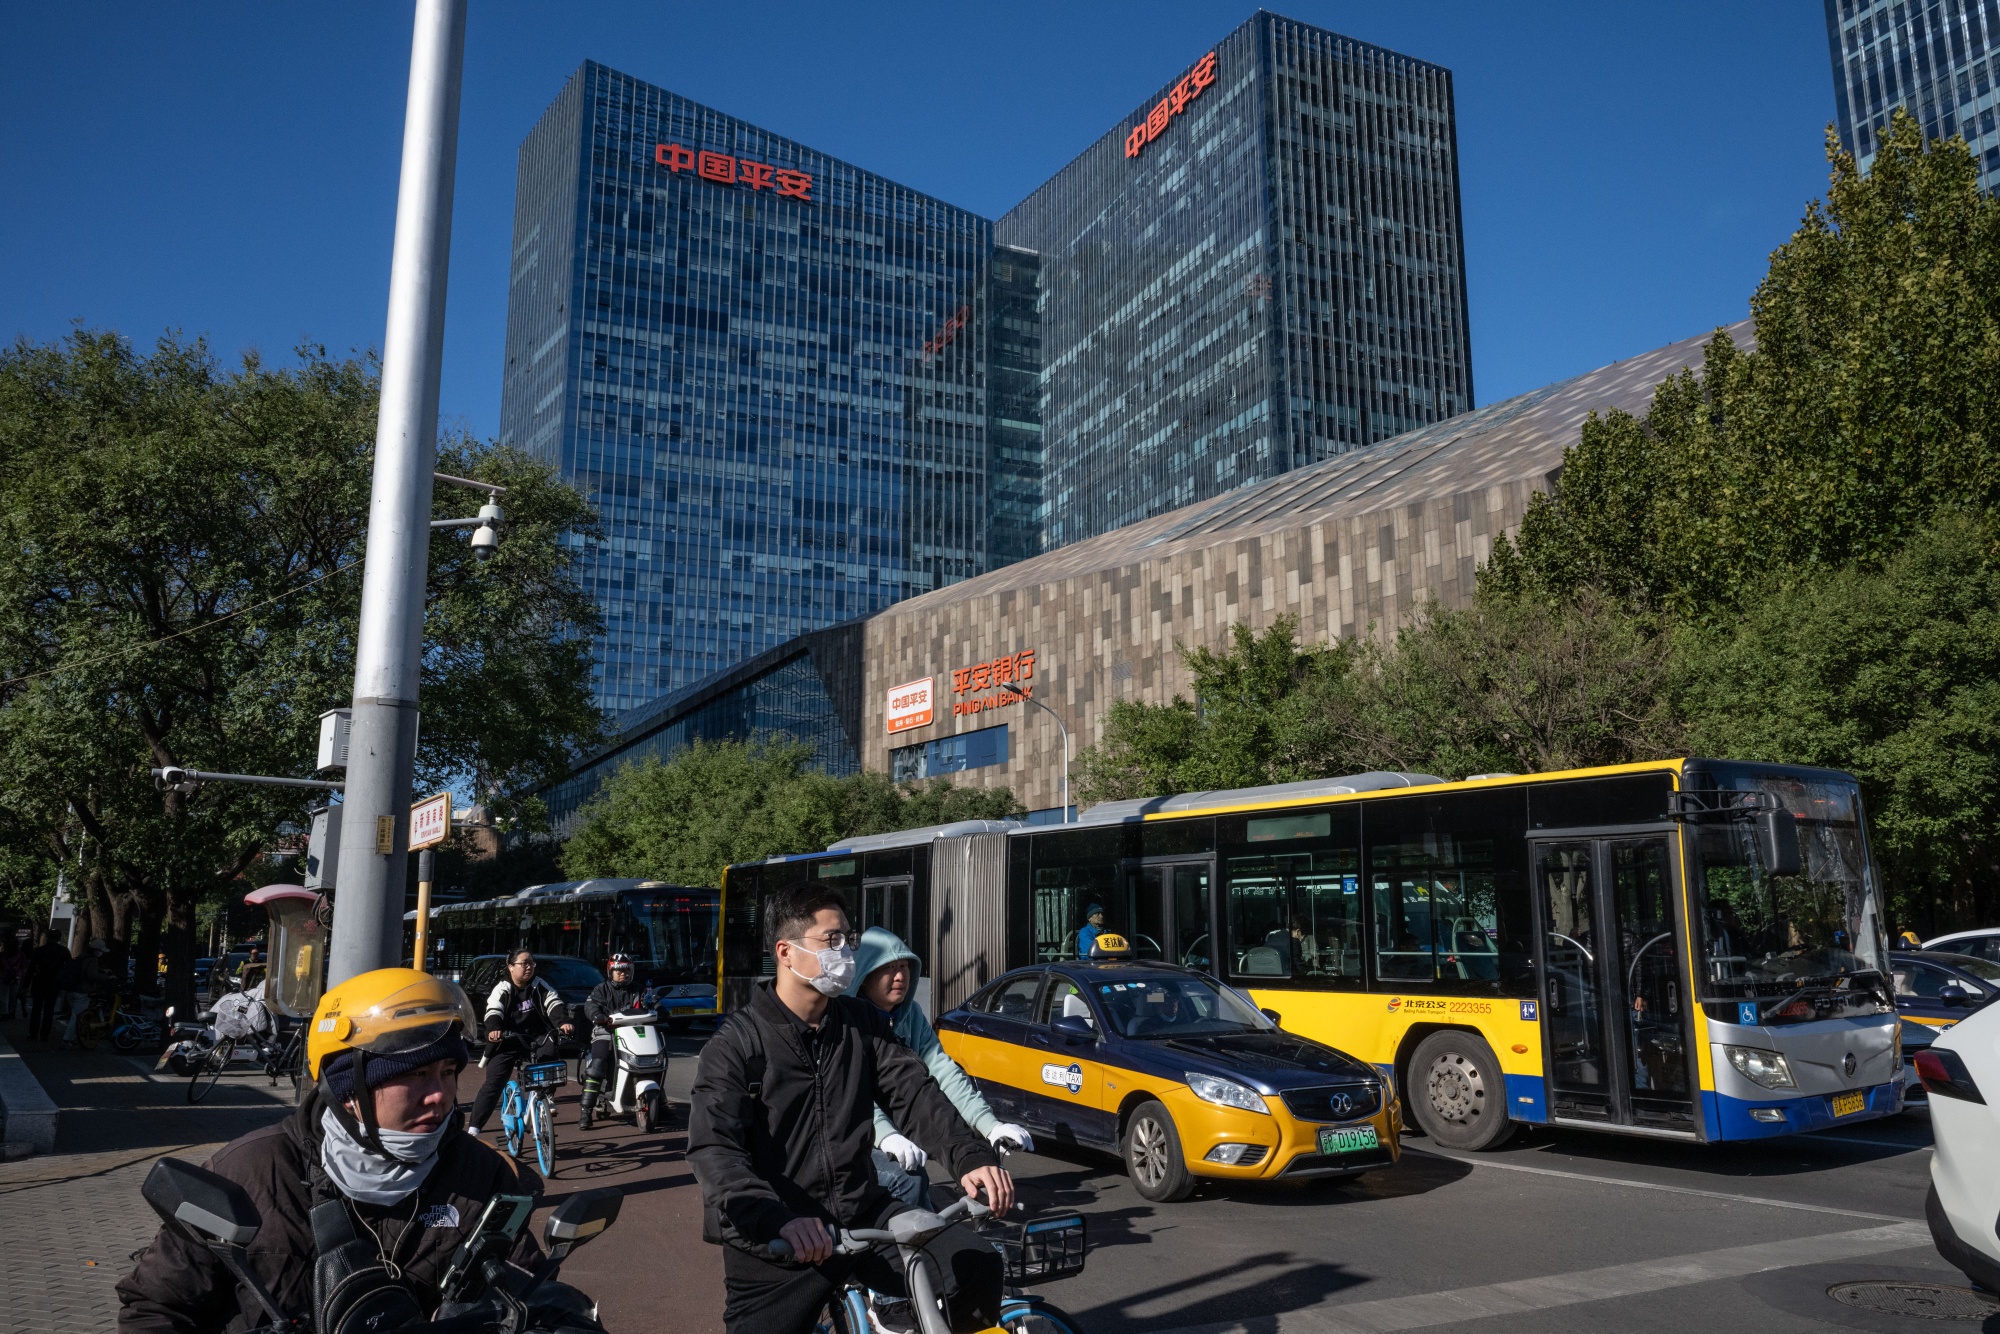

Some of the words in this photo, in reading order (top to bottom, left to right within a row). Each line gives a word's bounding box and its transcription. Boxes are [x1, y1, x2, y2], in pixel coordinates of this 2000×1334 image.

[1125, 51, 1215, 158] 中国平安
[655, 143, 813, 201] 中国平安
[952, 649, 1035, 696] 平安银行
[892, 689, 928, 711] 中国平安
[953, 698, 981, 718] PING
[982, 693, 999, 712] AN
[1001, 685, 1033, 707] BANK
[1404, 1000, 1447, 1009] 北京公交
[1449, 1002, 1492, 1014] 2223355
[1067, 1073, 1082, 1084] TAXI
[430, 1204, 447, 1213] THE
[418, 1212, 446, 1222] NORTH
[424, 1219, 446, 1228] FACE
